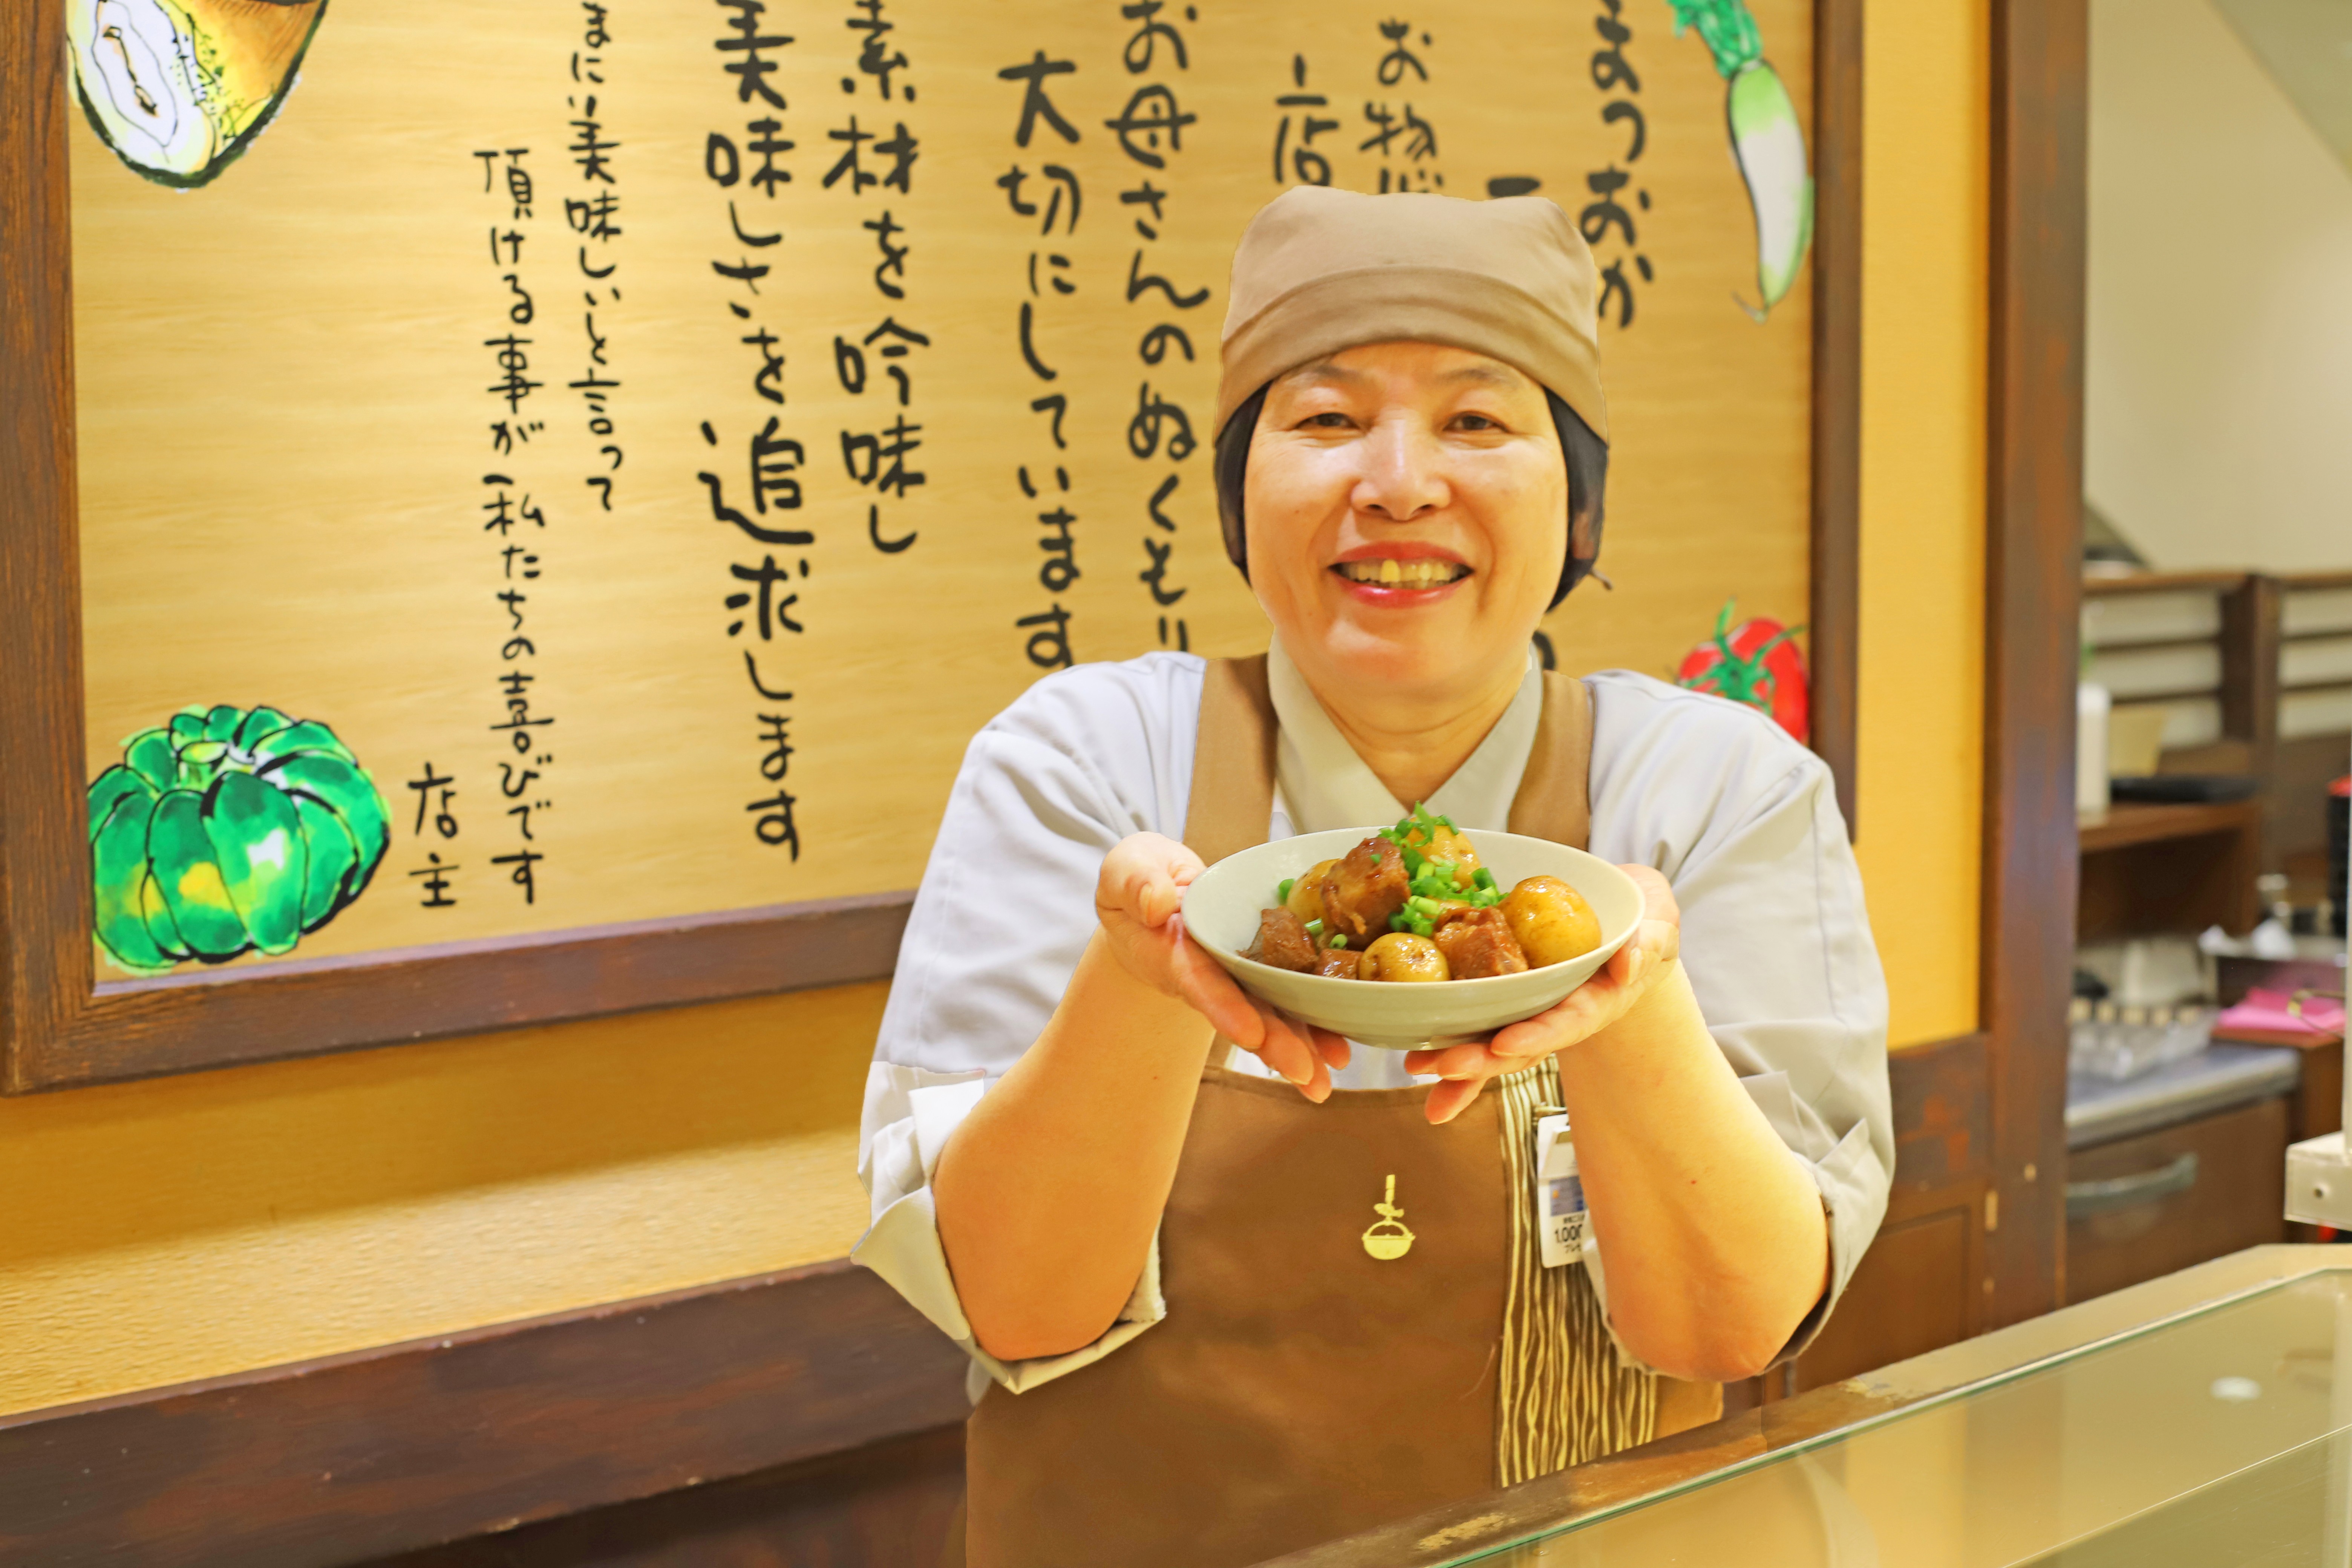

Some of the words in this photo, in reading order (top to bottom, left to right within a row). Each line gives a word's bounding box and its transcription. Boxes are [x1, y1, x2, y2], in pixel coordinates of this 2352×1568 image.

[564, 2, 623, 511] まに美味しいと言って
[697, 0, 815, 863] 美味しさを追求します
[821, 0, 931, 554] 素材を吟味し
[995, 49, 1083, 668] 大切にしています
[1102, 0, 1211, 653] お母さんのぬくもり
[1578, 0, 1655, 330] まつおか
[473, 148, 554, 905] 頂ける事が私たちの喜びです
[407, 761, 459, 909] 店主
